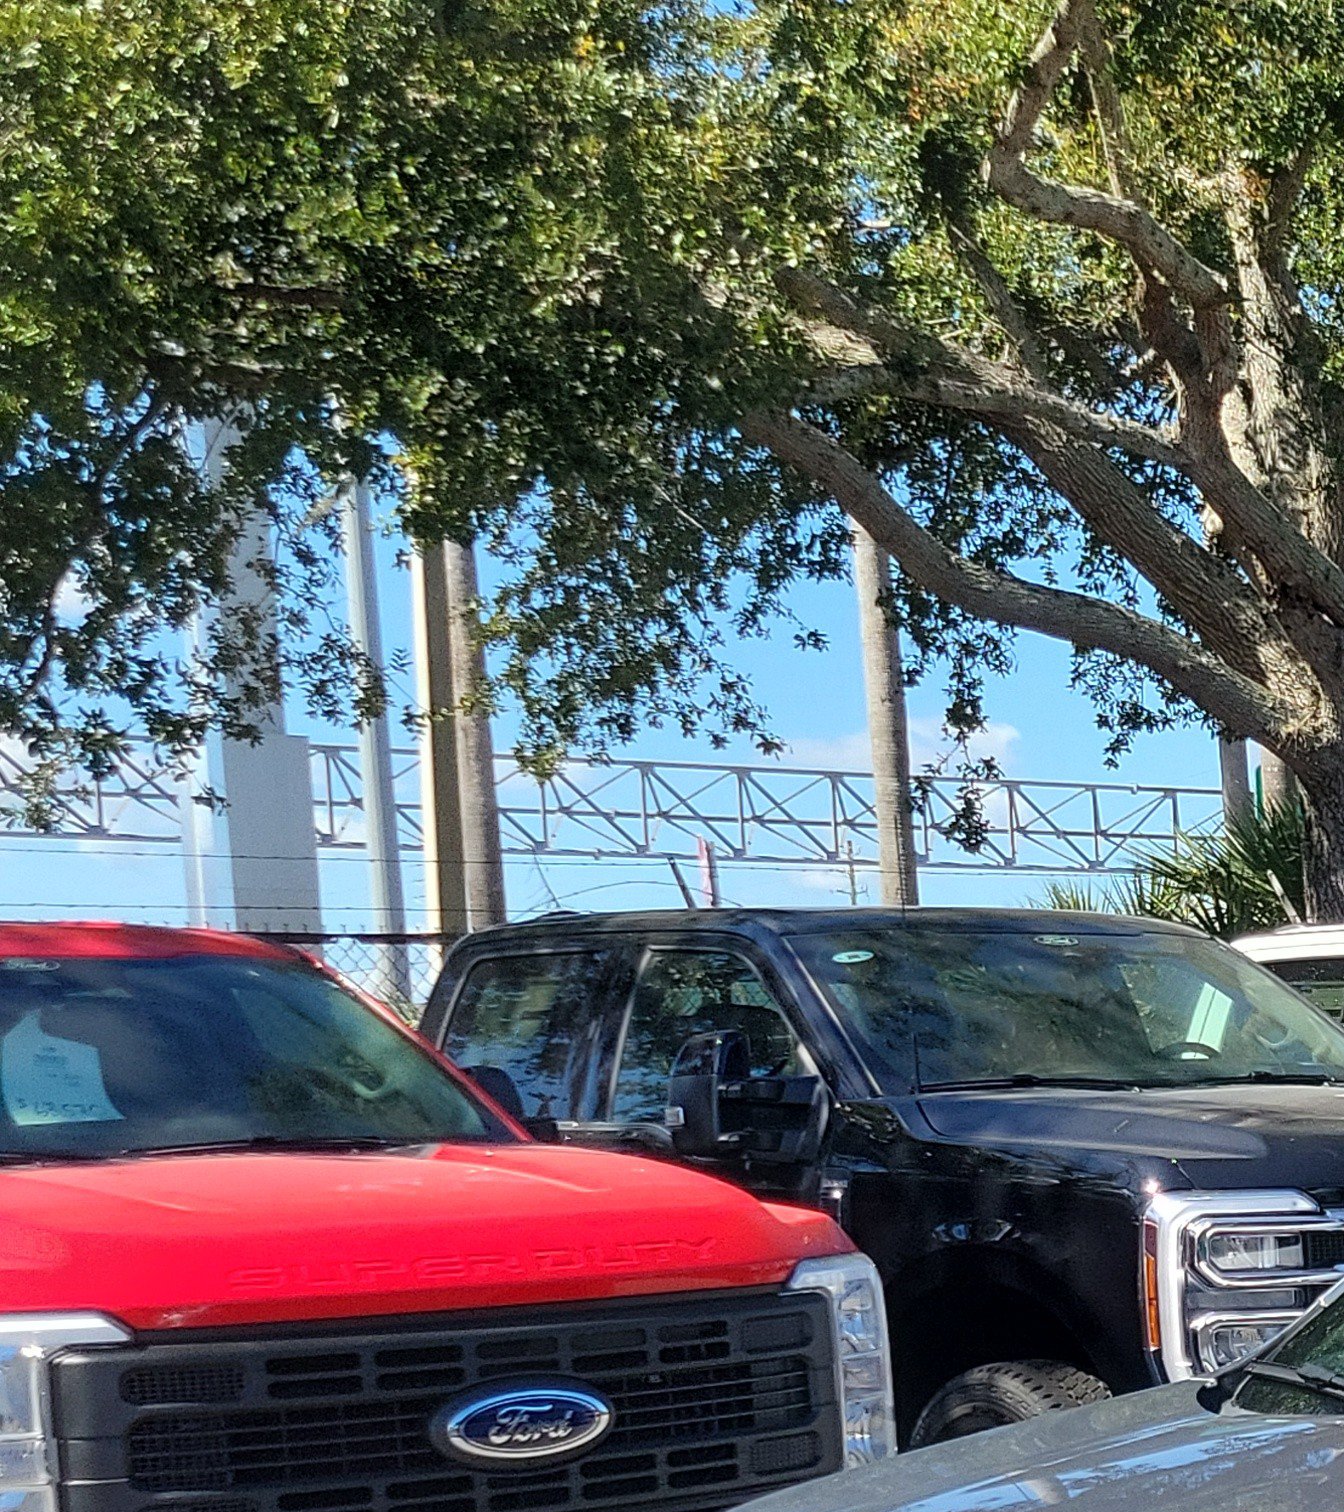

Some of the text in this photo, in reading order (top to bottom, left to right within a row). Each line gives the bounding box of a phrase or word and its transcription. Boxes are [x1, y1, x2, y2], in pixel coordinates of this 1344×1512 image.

[227, 1236, 718, 1291] SUPER DUTY
[488, 1403, 574, 1444] Ford
